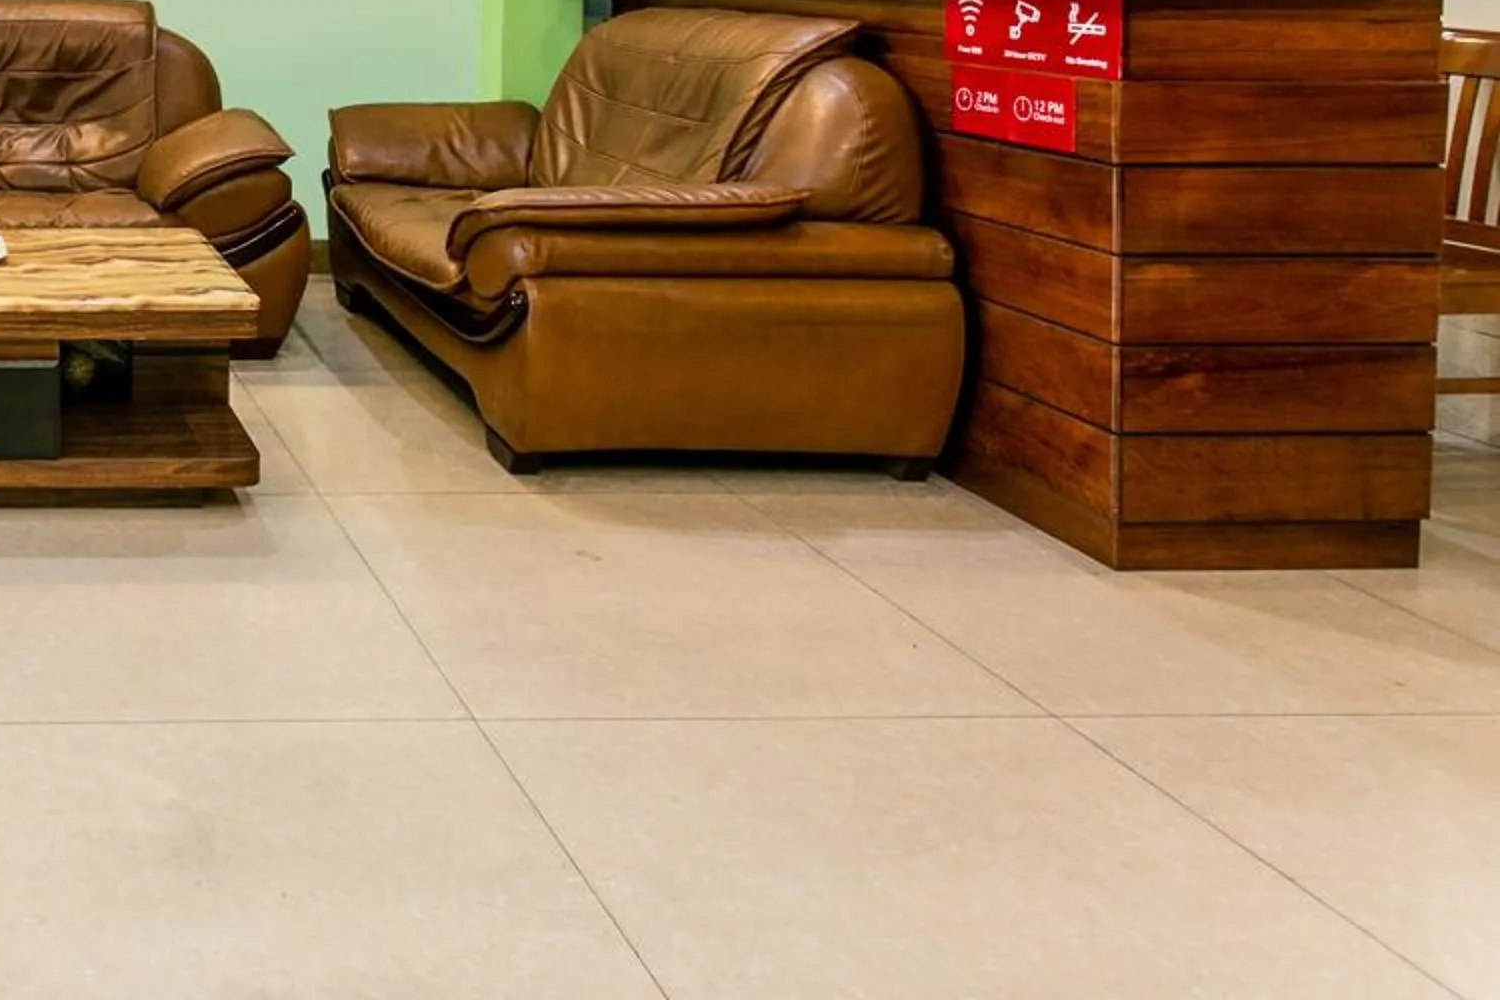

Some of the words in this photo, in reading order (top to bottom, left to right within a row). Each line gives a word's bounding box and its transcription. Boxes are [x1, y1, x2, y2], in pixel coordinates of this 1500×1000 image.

[983, 92, 998, 105] PM
[1033, 99, 1045, 113] 12
[1047, 101, 1065, 115] PM
